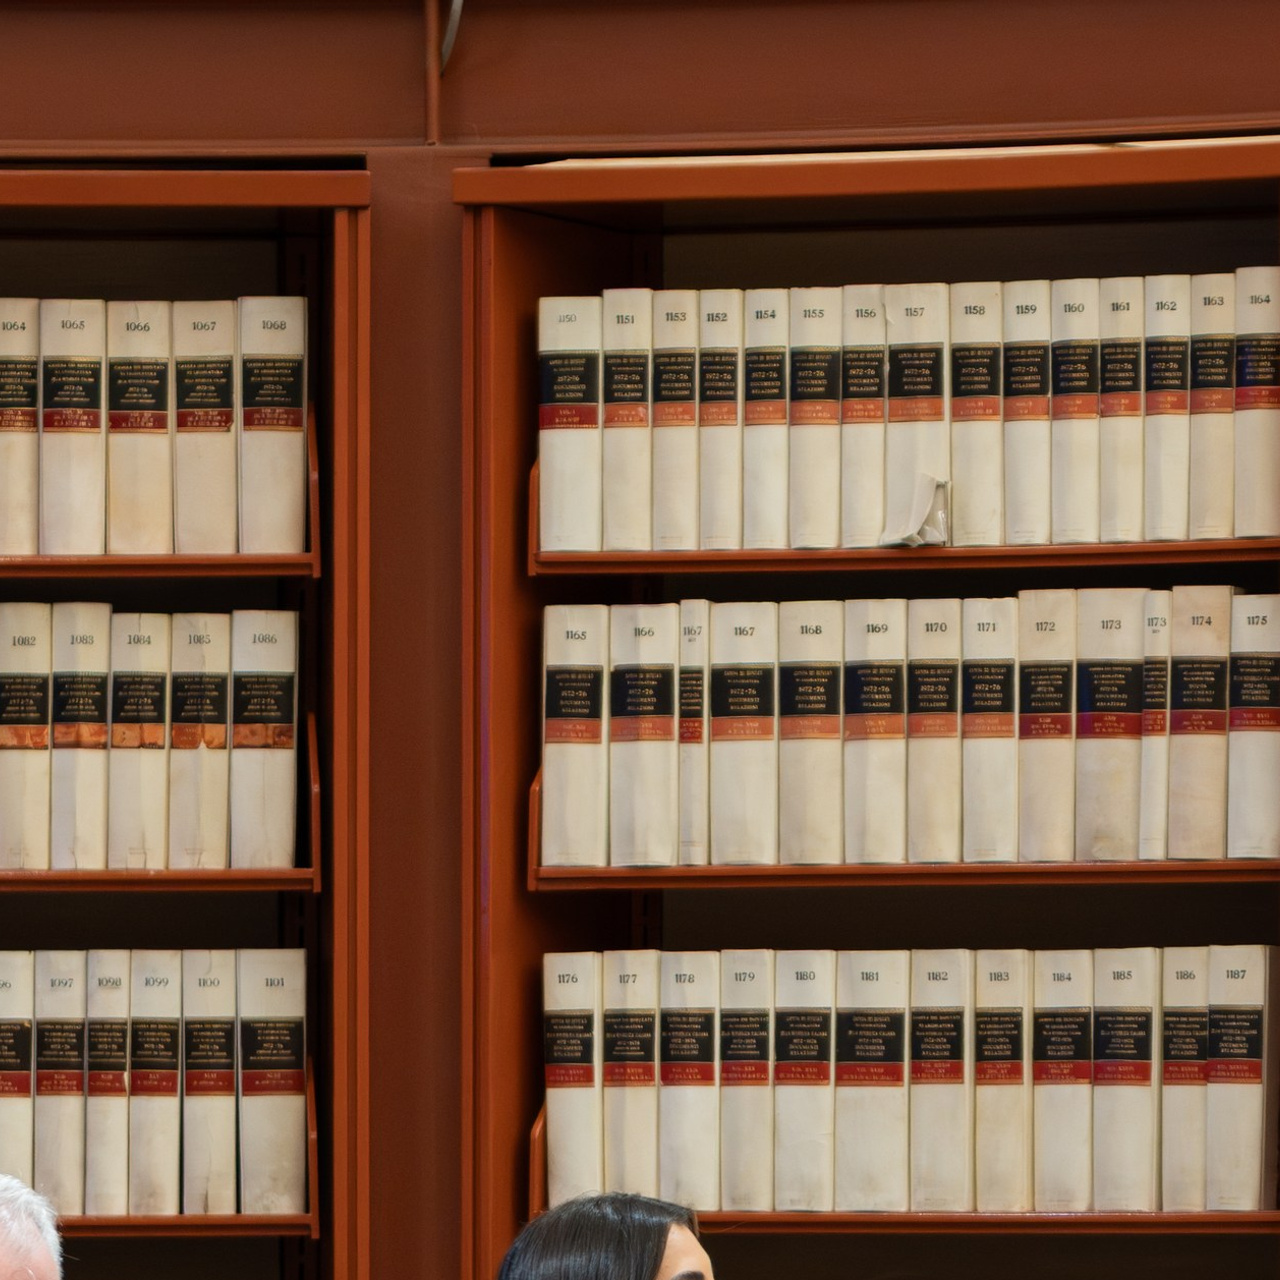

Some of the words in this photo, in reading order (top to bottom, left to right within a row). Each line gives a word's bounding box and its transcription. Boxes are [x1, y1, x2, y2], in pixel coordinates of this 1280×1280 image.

[1203, 296, 1224, 306] 1163
[1250, 295, 1271, 304] 1164
[964, 305, 986, 315] 1158
[1016, 305, 1037, 315] 1159
[1063, 303, 1085, 313] 1160
[1111, 302, 1130, 312] 1161
[1155, 301, 1177, 311] 1162
[665, 312, 687, 322] 1153
[706, 312, 728, 322] 1152
[755, 310, 776, 319] 1154
[803, 309, 824, 318] 1155
[855, 309, 876, 318] 1156
[905, 307, 925, 317] 1157
[61, 319, 85, 330] 1065
[616, 315, 635, 324] 1151
[2, 321, 26, 331] 1064
[126, 321, 150, 332] 1066
[192, 321, 216, 331] 1067
[262, 320, 286, 331] 1068
[1101, 620, 1122, 630] 1173
[1147, 617, 1167, 627] 1173
[1191, 616, 1212, 626] 1174
[1247, 615, 1268, 625] 1175
[683, 626, 703, 636] 1167
[800, 625, 822, 635] 1168
[866, 623, 889, 633] 1169
[925, 623, 947, 633] 1170
[977, 622, 996, 632] 1171
[1036, 621, 1056, 631] 1172
[565, 630, 587, 640] 1165
[634, 627, 655, 637] 1166
[734, 627, 755, 636] 1167
[12, 636, 36, 646] 1082
[70, 635, 94, 645] 1083
[127, 634, 152, 645] 1084
[188, 634, 211, 644] 1085
[252, 633, 277, 644] 1086
[558, 974, 578, 984] 1176
[619, 974, 637, 984] 1177
[675, 973, 695, 983] 1178
[735, 972, 755, 982] 1179
[795, 971, 816, 981] 1180
[861, 971, 879, 981] 1181
[927, 971, 949, 981] 1182
[989, 972, 1010, 982] 1183
[1052, 972, 1072, 982] 1184
[1112, 970, 1133, 980] 1185
[1175, 970, 1196, 980] 1186
[1226, 969, 1247, 980] 1187
[50, 978, 73, 988] 1097
[97, 977, 122, 987] 1098
[144, 977, 169, 987] 1099
[198, 978, 220, 987] 1100
[265, 977, 285, 987] 1101
